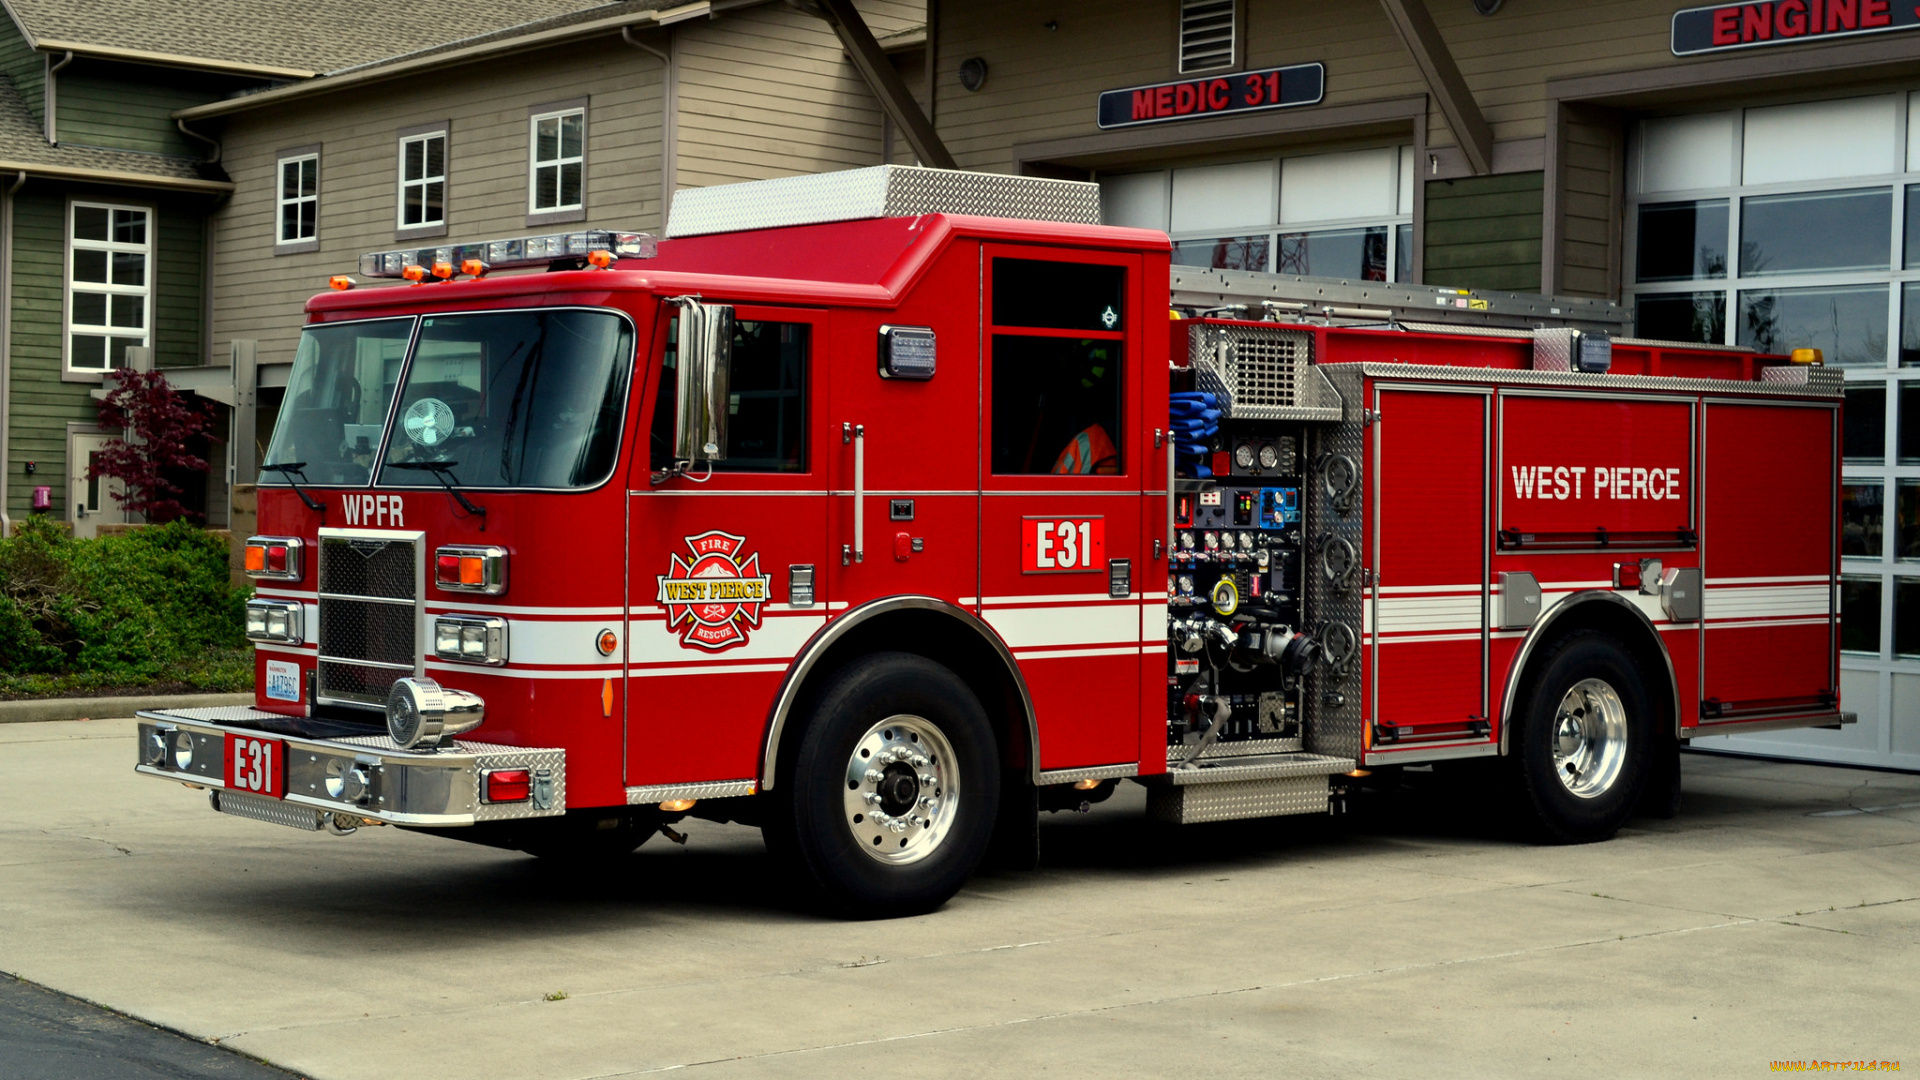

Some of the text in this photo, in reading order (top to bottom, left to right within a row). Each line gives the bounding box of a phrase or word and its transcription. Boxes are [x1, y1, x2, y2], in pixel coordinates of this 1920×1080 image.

[1712, 0, 1891, 46] ENGINE
[1132, 71, 1281, 121] MEDIC 31
[1511, 465, 1680, 501] WEST PIERCE
[342, 493, 404, 527] WPFR
[700, 538, 731, 552] FIRE
[1036, 520, 1091, 569] E31
[666, 581, 763, 601] WEST PIERCE
[697, 627, 732, 640] RESCUE
[233, 739, 273, 793] E31
